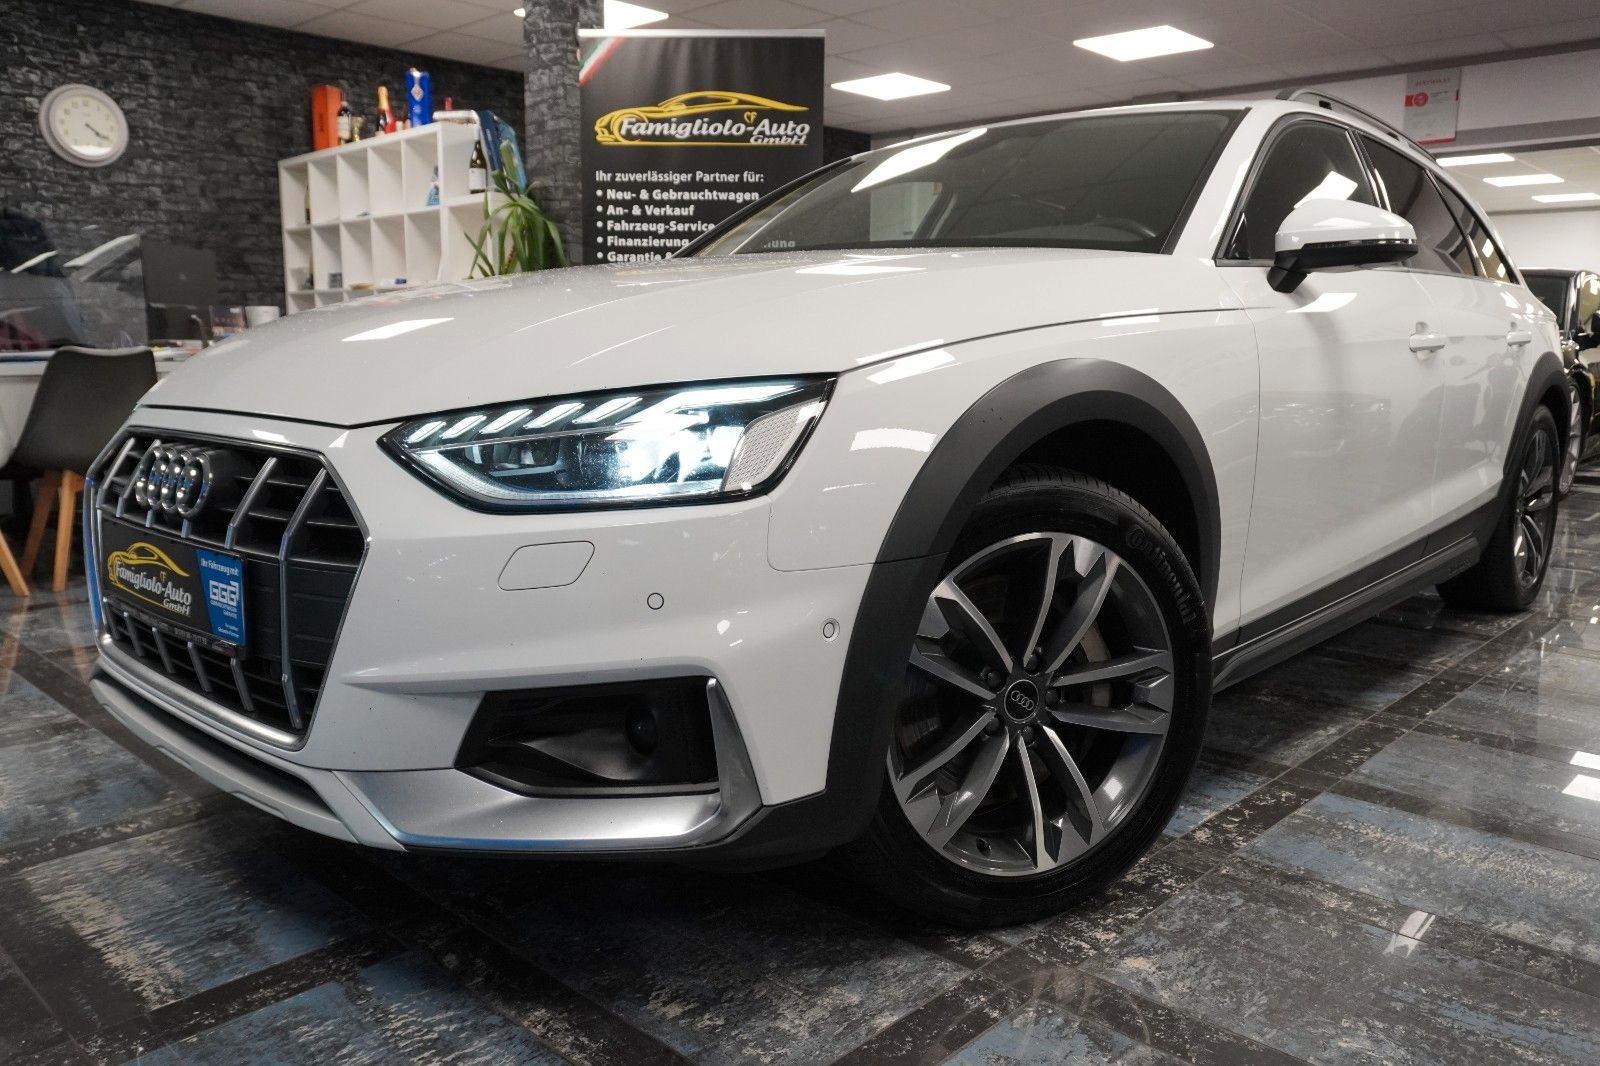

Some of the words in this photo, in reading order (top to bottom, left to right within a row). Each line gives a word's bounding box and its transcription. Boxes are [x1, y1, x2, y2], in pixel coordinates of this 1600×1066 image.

[620, 117, 810, 140] Famigliolo-Auto
[750, 134, 807, 145] GmbH
[595, 171, 612, 182] Ihr
[615, 170, 692, 184] zuverlässiger
[696, 171, 740, 182] Partner
[743, 170, 764, 182] für:
[606, 190, 636, 200] Neu-
[639, 190, 649, 200] &
[652, 189, 760, 203] Gebrauchtwagen
[606, 205, 629, 215] An-
[631, 205, 641, 215] &
[644, 204, 695, 215] Verkauf
[606, 220, 715, 234] Fahrzeug-Service
[115, 560, 192, 605] Famigliolo-Auto
[163, 599, 191, 616] GmbH
